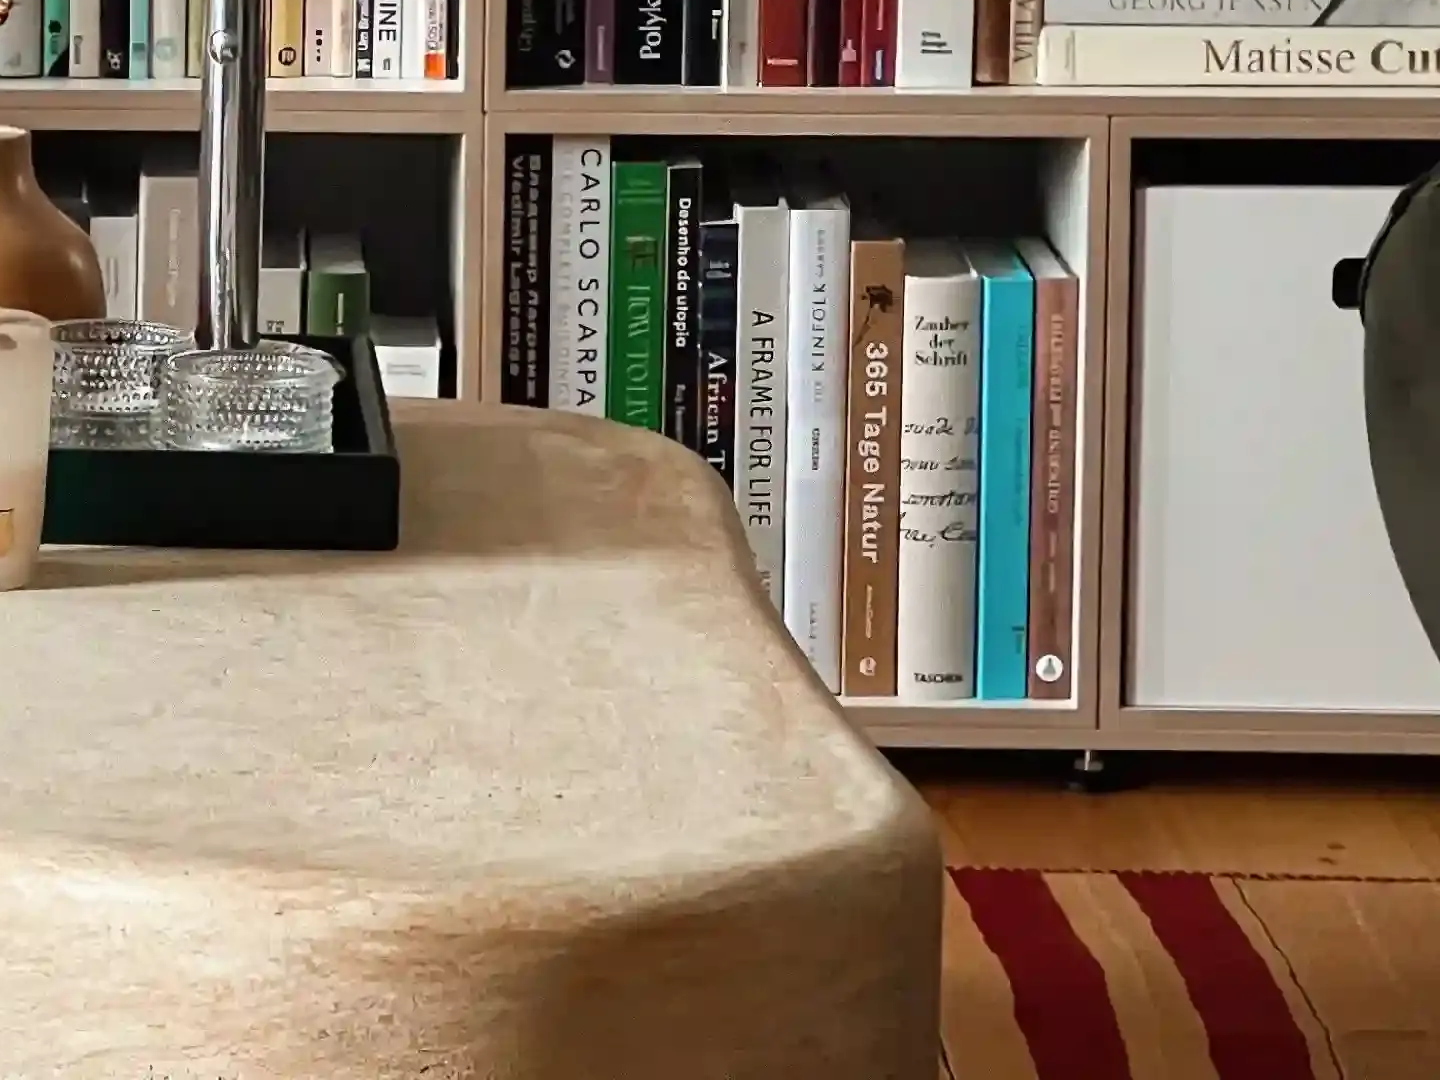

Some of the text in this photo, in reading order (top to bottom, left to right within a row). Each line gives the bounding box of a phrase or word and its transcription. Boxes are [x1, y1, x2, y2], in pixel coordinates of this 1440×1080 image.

[1202, 37, 1356, 75] Matisse
[506, 155, 527, 377] Vladimir Lagrange
[576, 149, 603, 408] CARLO SCARPA
[626, 284, 652, 338] HOW
[671, 197, 693, 349] Desenho da utopia
[914, 315, 970, 332] Zauber
[810, 283, 828, 374] KINFOLK
[706, 350, 730, 446] African
[747, 310, 775, 527] A FRAME FOR LIFE
[858, 342, 890, 564] 365 Tage Natur
